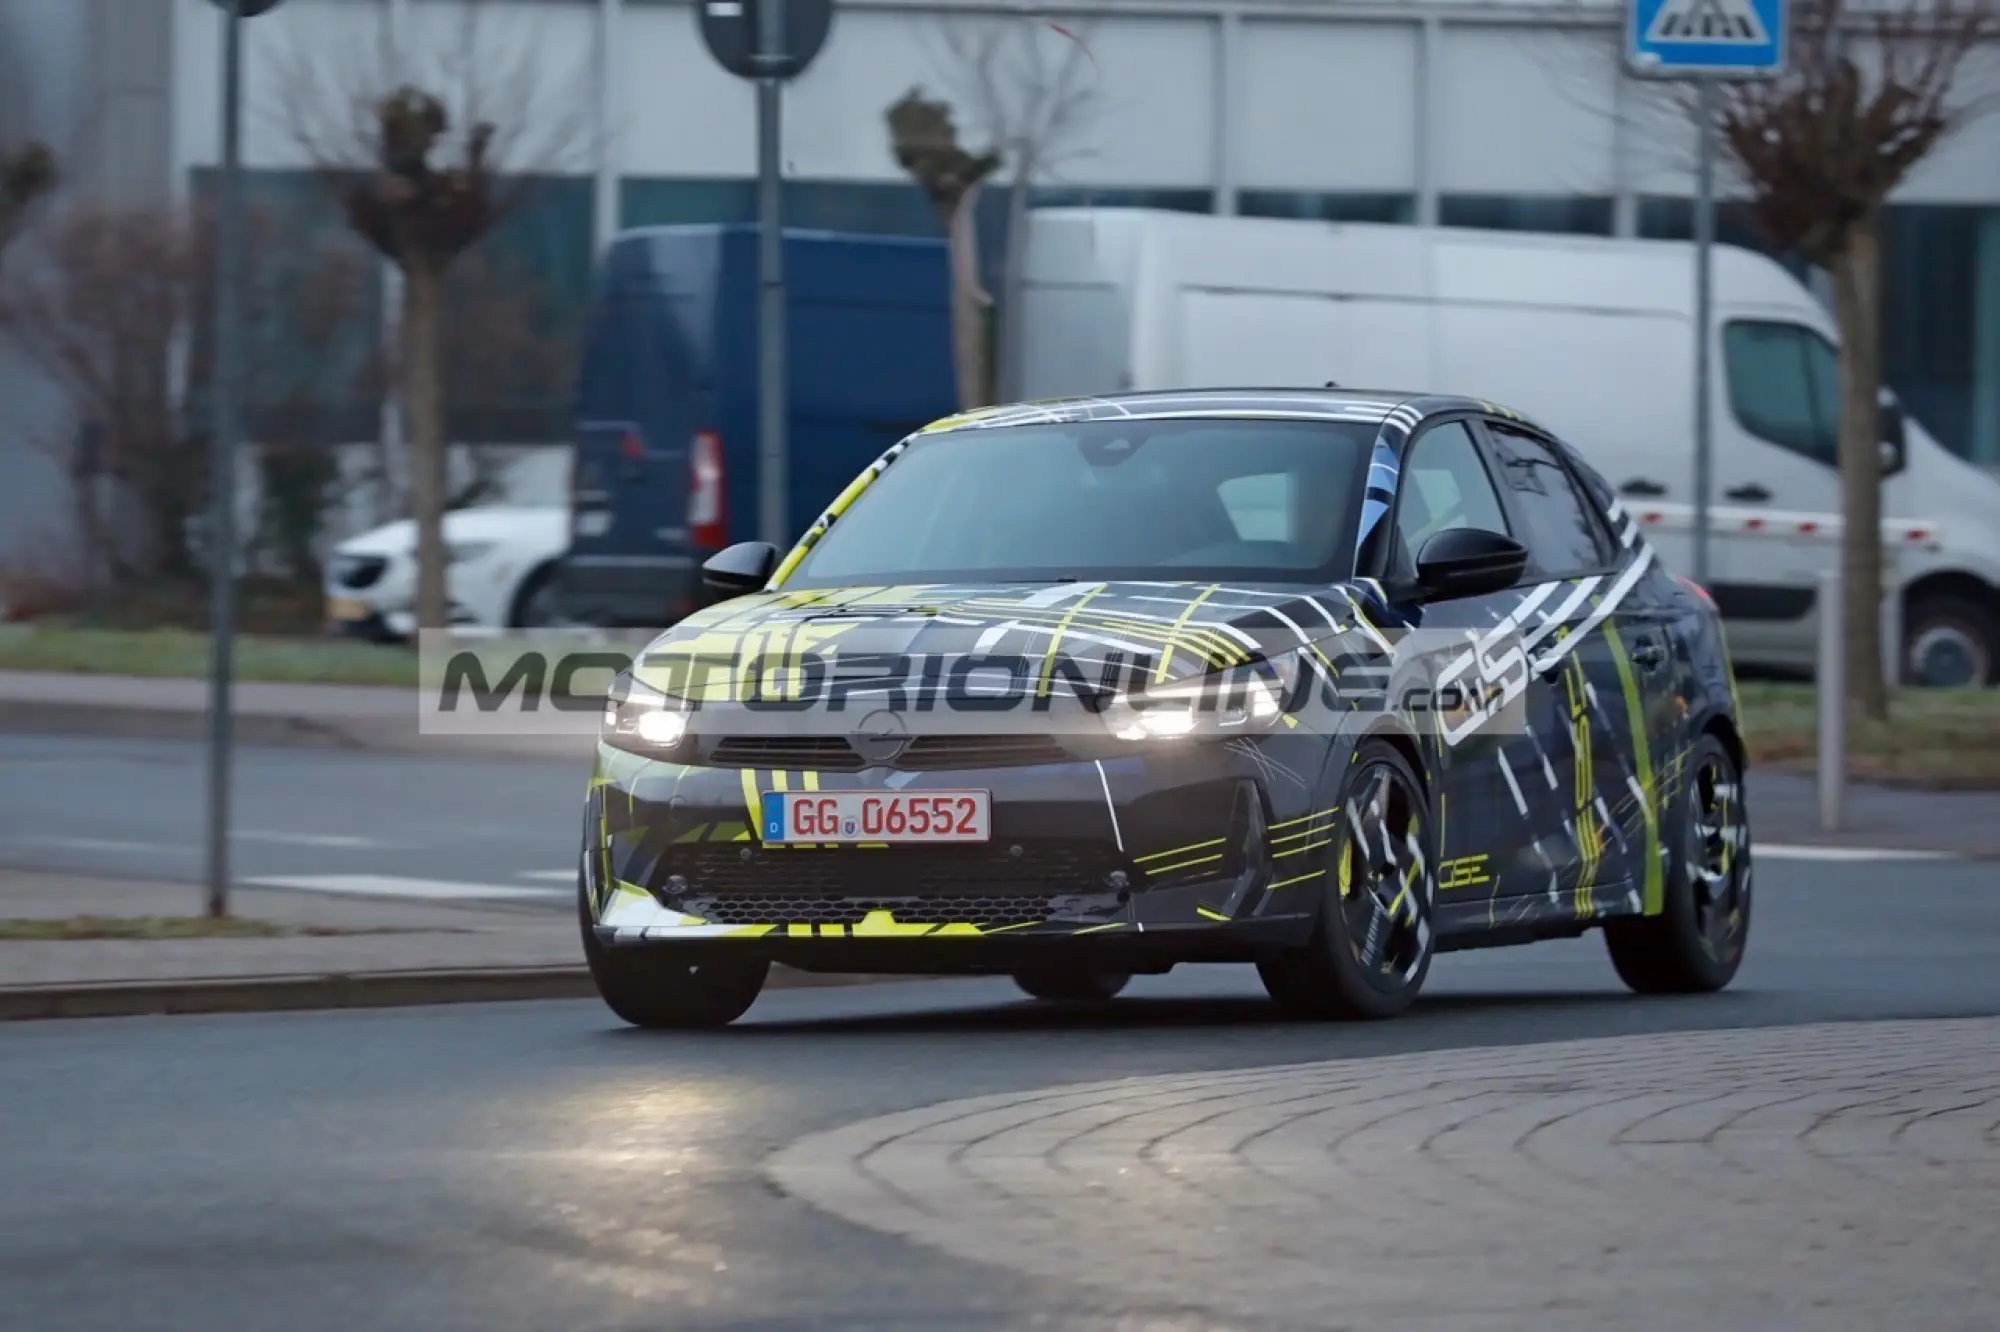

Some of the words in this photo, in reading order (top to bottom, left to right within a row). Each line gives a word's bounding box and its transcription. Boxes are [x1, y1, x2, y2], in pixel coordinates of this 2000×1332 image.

[769, 821, 780, 834] D
[793, 798, 838, 835] GG
[862, 797, 977, 835] 06552
